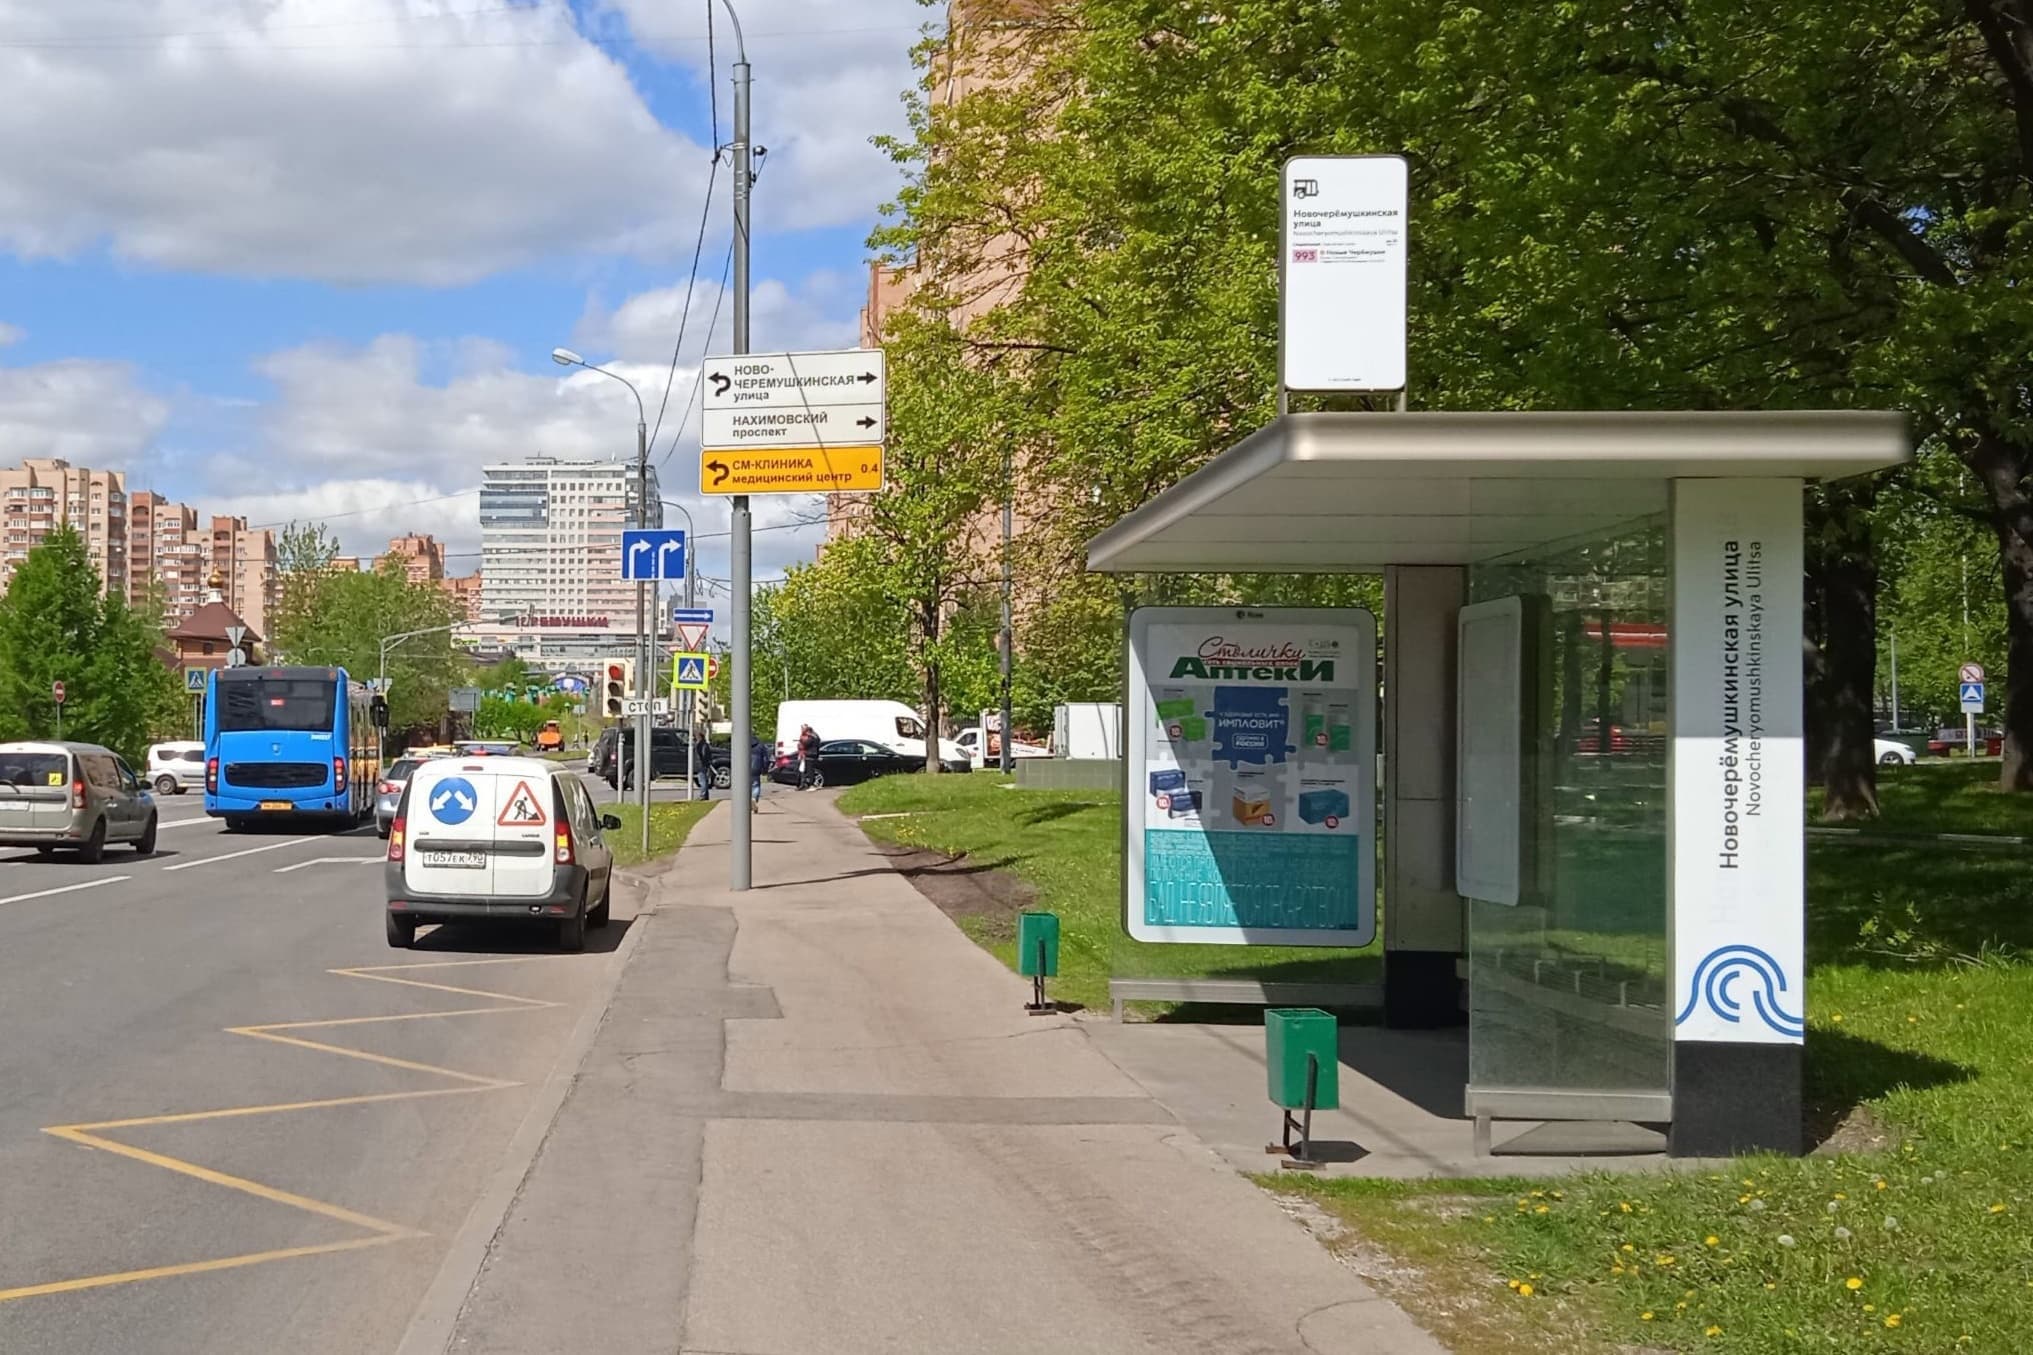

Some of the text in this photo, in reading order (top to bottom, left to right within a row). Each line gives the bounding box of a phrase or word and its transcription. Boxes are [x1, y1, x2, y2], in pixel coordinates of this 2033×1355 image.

[1293, 209, 1398, 219] Новочерёмушкинская
[1293, 220, 1321, 229] улица
[1295, 251, 1316, 260] 993
[734, 364, 774, 376] НОВО-
[734, 375, 855, 389] ЧЕРЕМУШКИНСКАЯ
[733, 391, 769, 403] улица
[732, 411, 828, 426] НАХИМОВСКИЙ
[732, 427, 787, 439] проспект
[732, 458, 813, 471] СМ-КЛИНИКА
[732, 472, 852, 485] медицинский центр
[1725, 541, 1743, 608] улица
[1198, 636, 1306, 660] Столички
[1746, 541, 1765, 816] Novocheryomushkinskaya Ulitsa
[1719, 613, 1743, 870] Новочерёмушкинская
